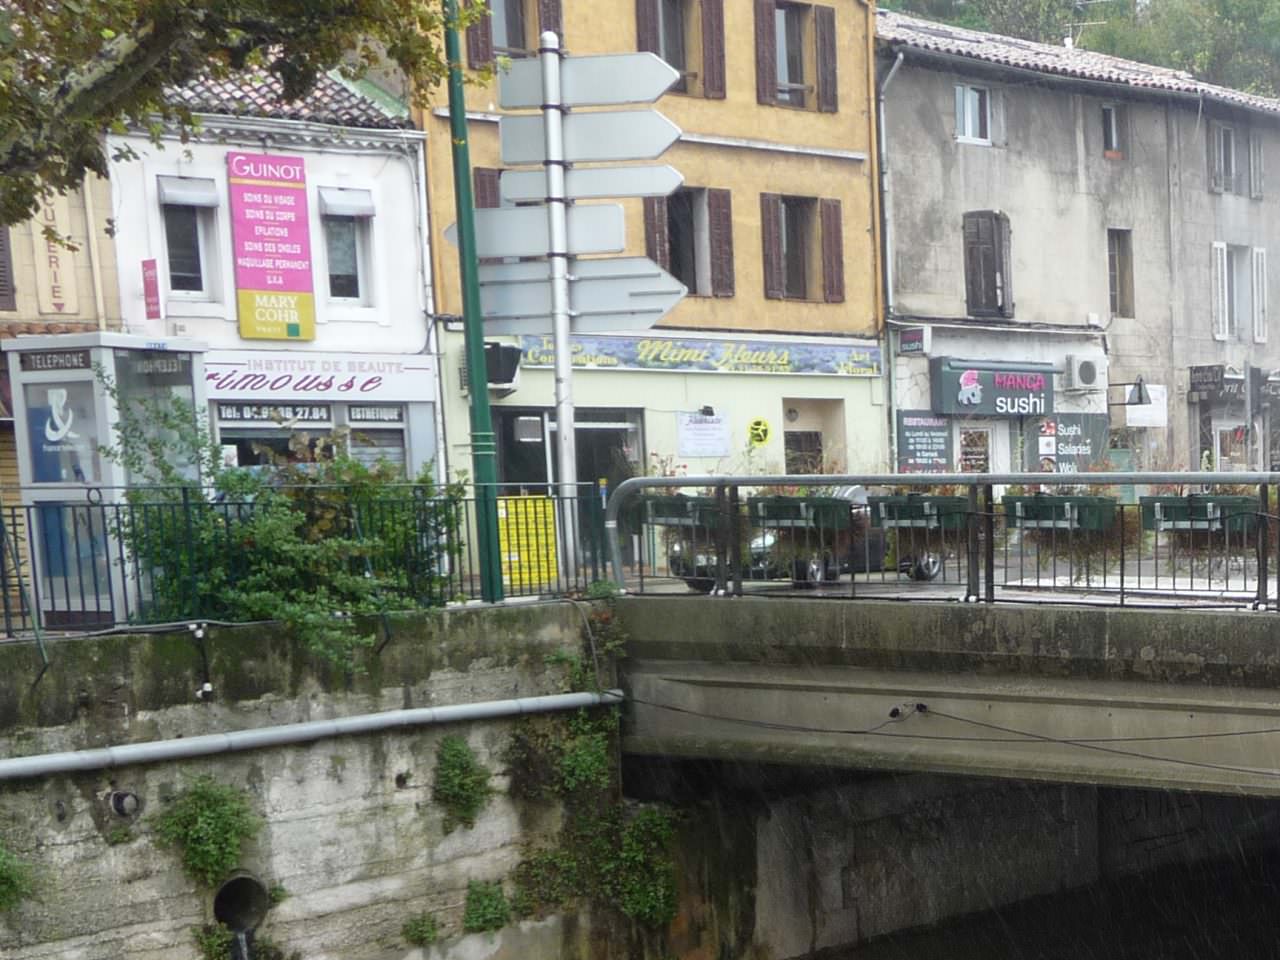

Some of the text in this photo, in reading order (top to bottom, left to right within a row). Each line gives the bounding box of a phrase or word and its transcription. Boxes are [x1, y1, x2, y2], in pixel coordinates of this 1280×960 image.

[232, 155, 301, 180] GUINOT
[256, 293, 299, 309] MARY
[256, 308, 300, 323] COHR
[638, 339, 711, 362] Mimi
[31, 353, 86, 369] TELEPHONE
[247, 359, 315, 372] INSTITUT
[322, 360, 341, 373] DE
[996, 394, 1045, 414] sushi
[1058, 423, 1081, 436] Sushi
